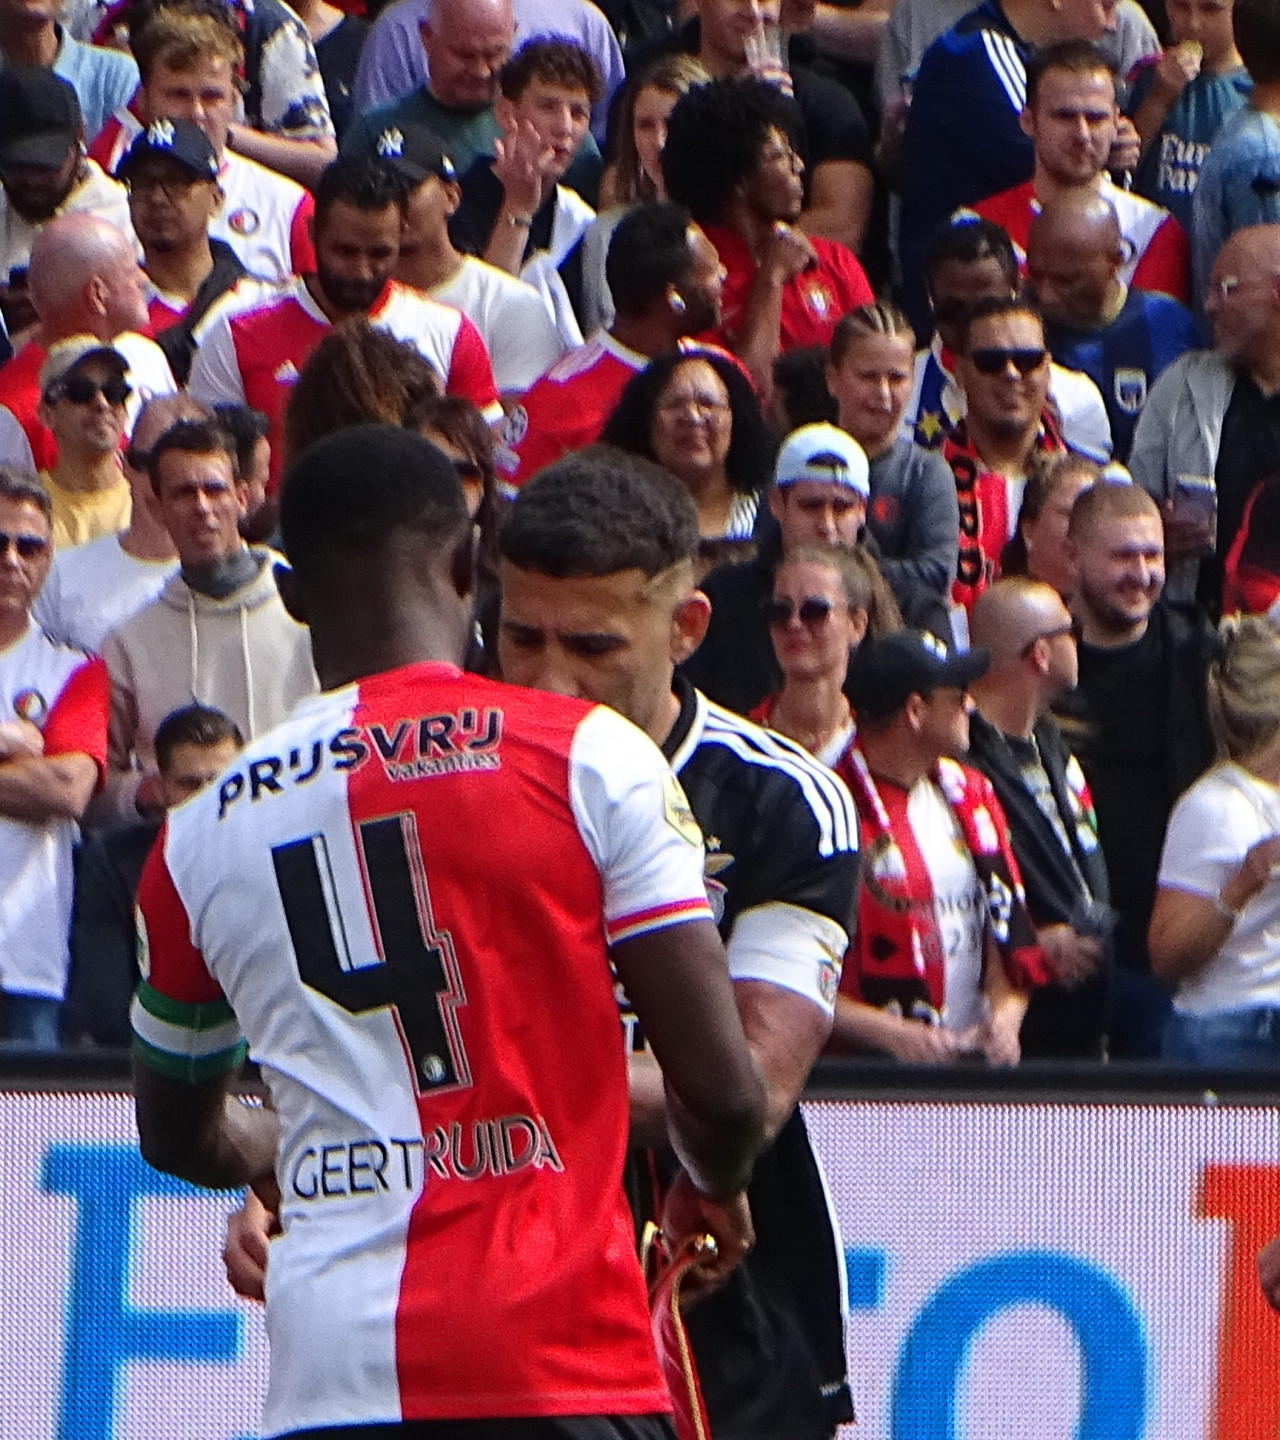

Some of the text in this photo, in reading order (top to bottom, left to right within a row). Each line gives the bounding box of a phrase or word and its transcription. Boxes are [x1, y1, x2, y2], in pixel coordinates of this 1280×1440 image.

[1157, 164, 1199, 195] Par
[1160, 132, 1212, 166] Eur
[271, 810, 474, 1099] 4
[291, 1113, 566, 1201] GEERTRUIDA
